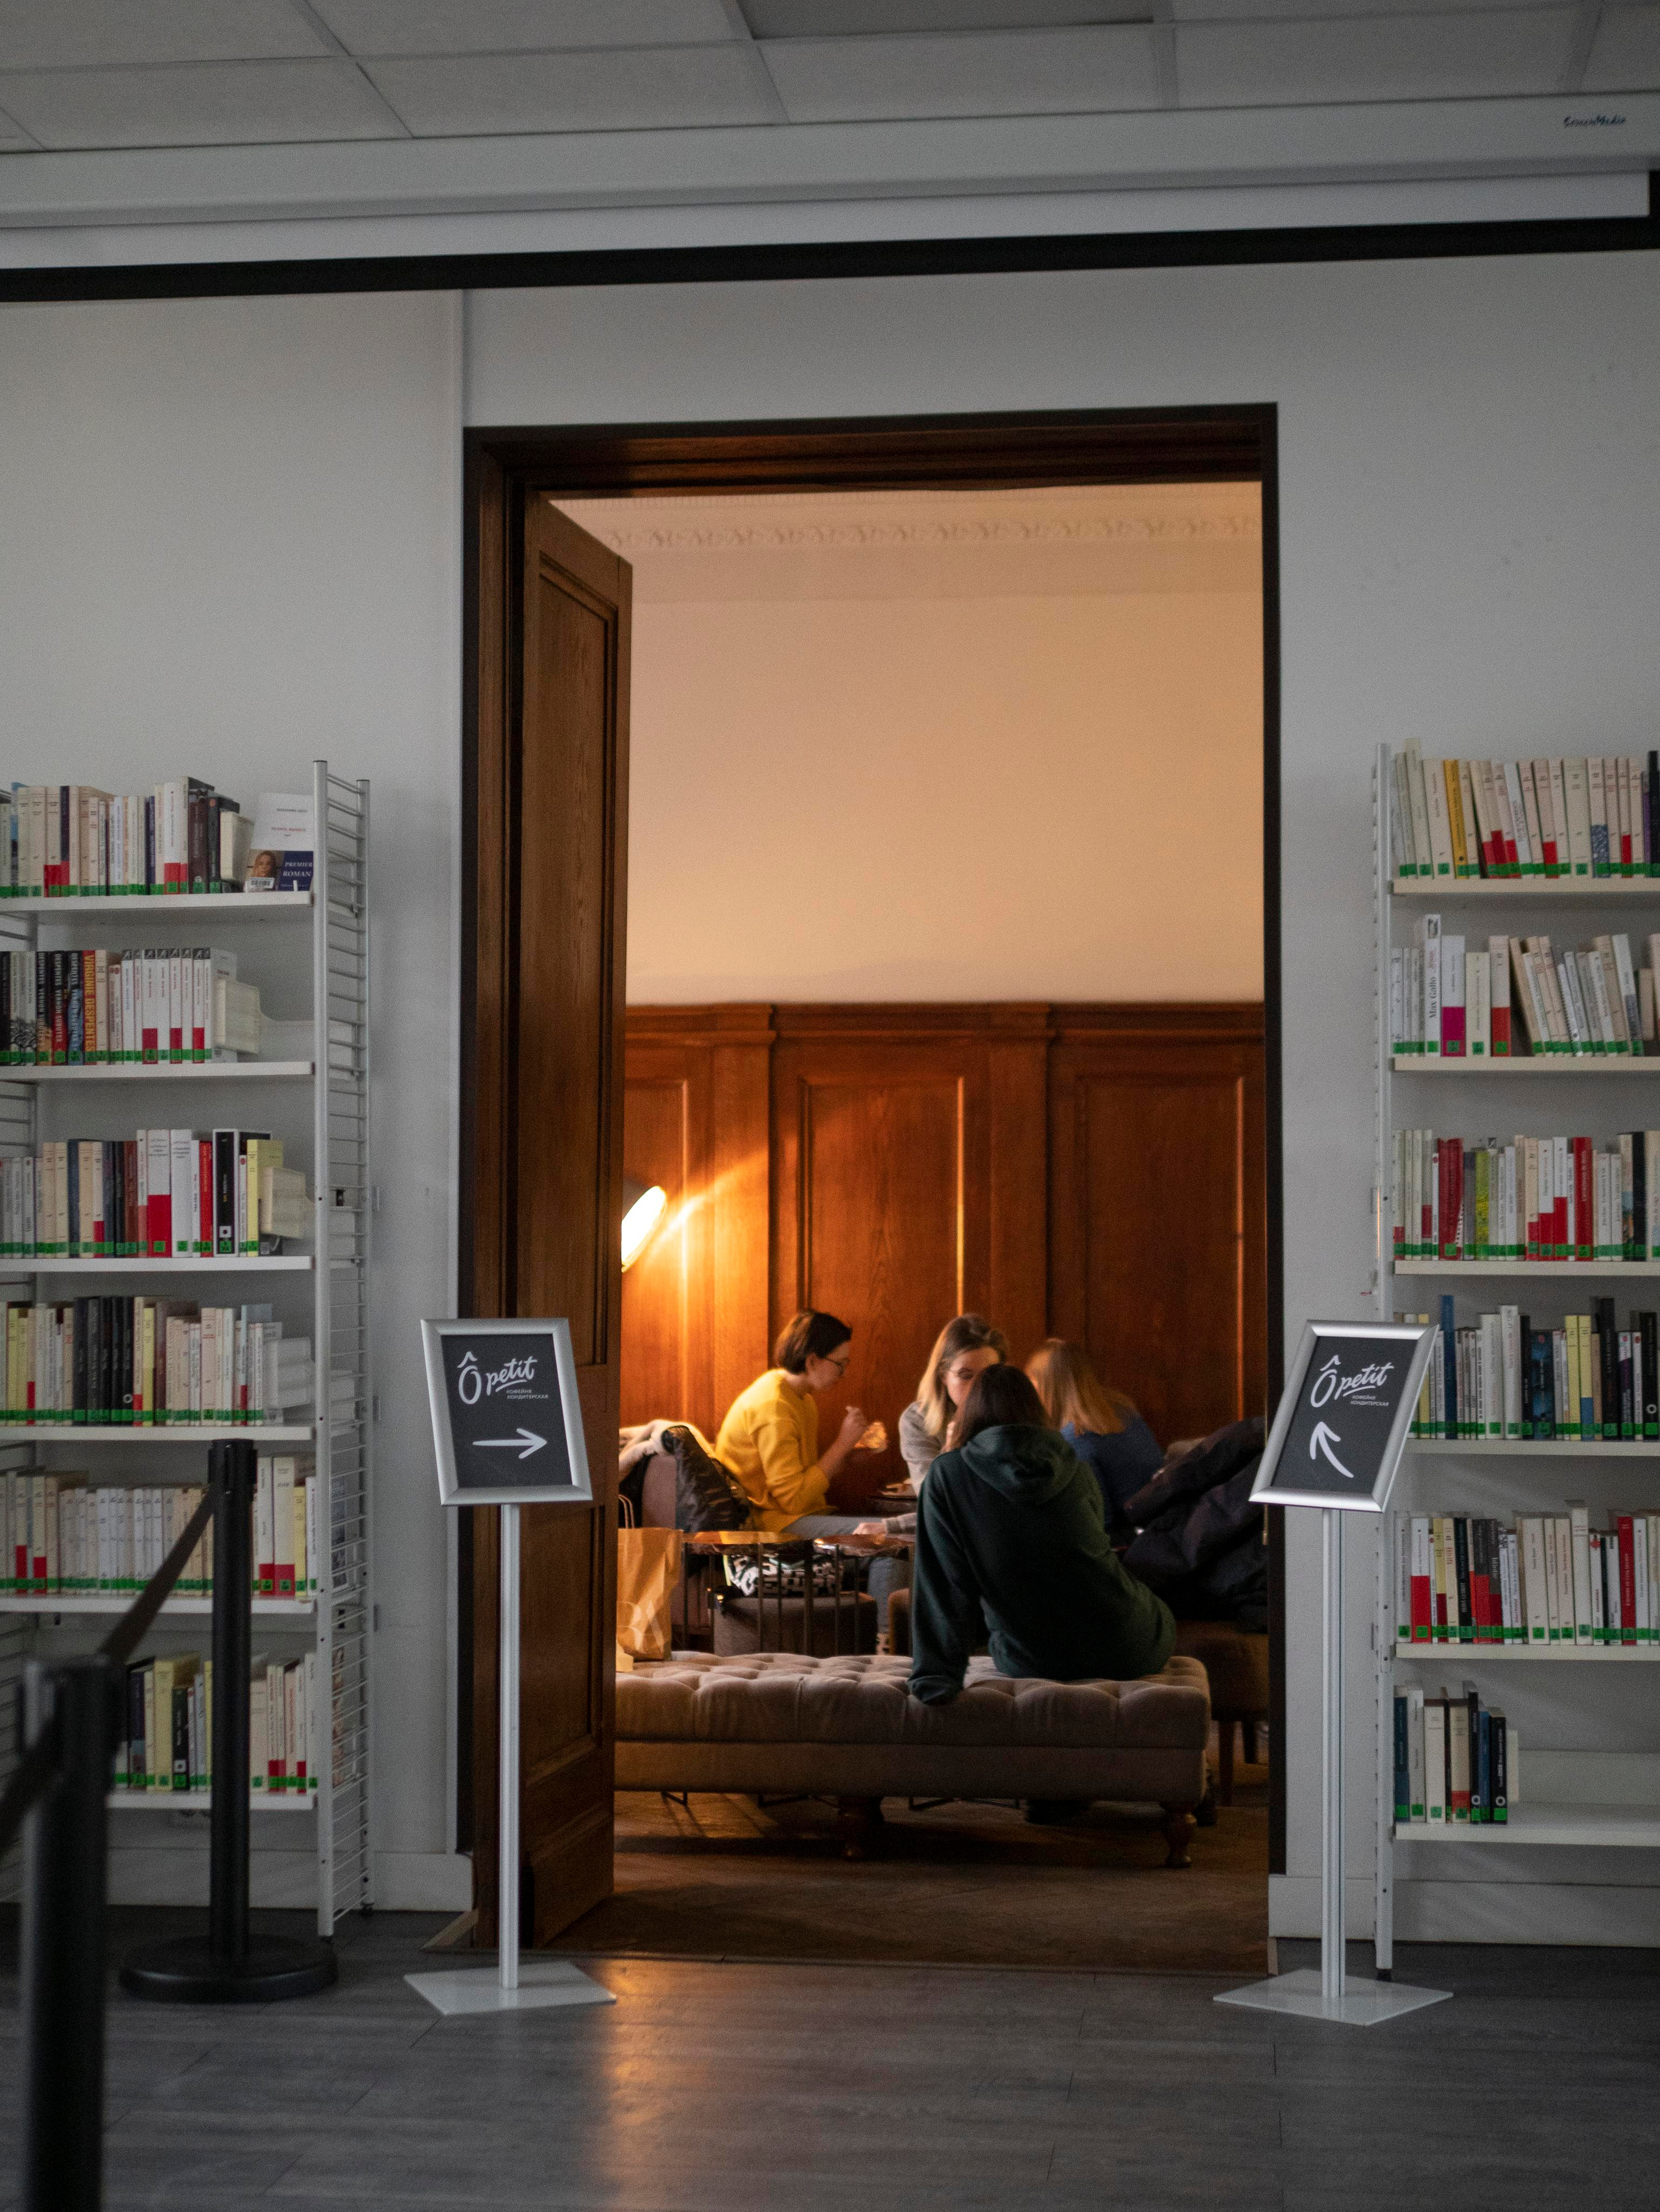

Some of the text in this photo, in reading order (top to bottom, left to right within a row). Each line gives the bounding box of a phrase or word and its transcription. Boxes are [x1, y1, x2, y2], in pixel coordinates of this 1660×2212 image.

[84, 955, 95, 1051] VIRGINIE DESPENTES
[1429, 976, 1437, 999] Gallo
[485, 1356, 538, 1396] petit
[1334, 1361, 1394, 1400] petit
